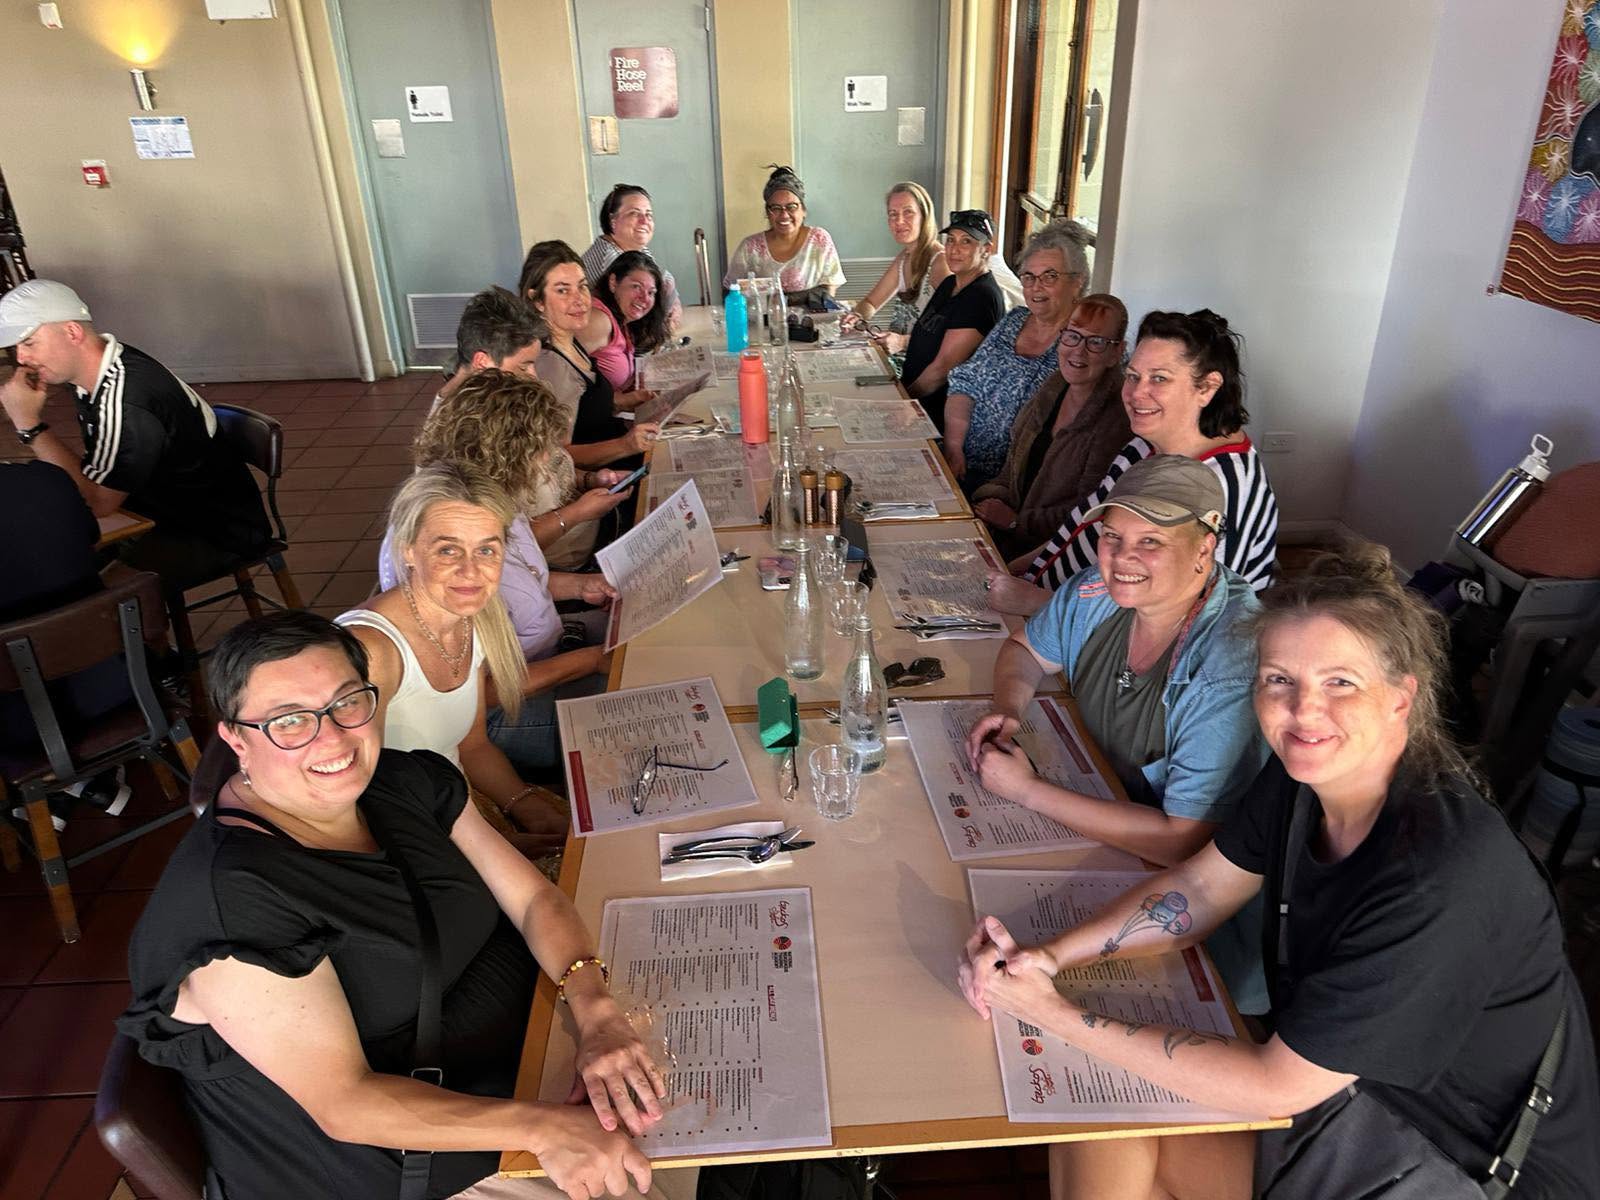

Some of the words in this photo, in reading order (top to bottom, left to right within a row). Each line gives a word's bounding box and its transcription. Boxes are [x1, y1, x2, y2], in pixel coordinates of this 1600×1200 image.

[614, 56, 640, 69] Fire
[615, 68, 647, 80] Hose
[616, 80, 645, 92] Reel
